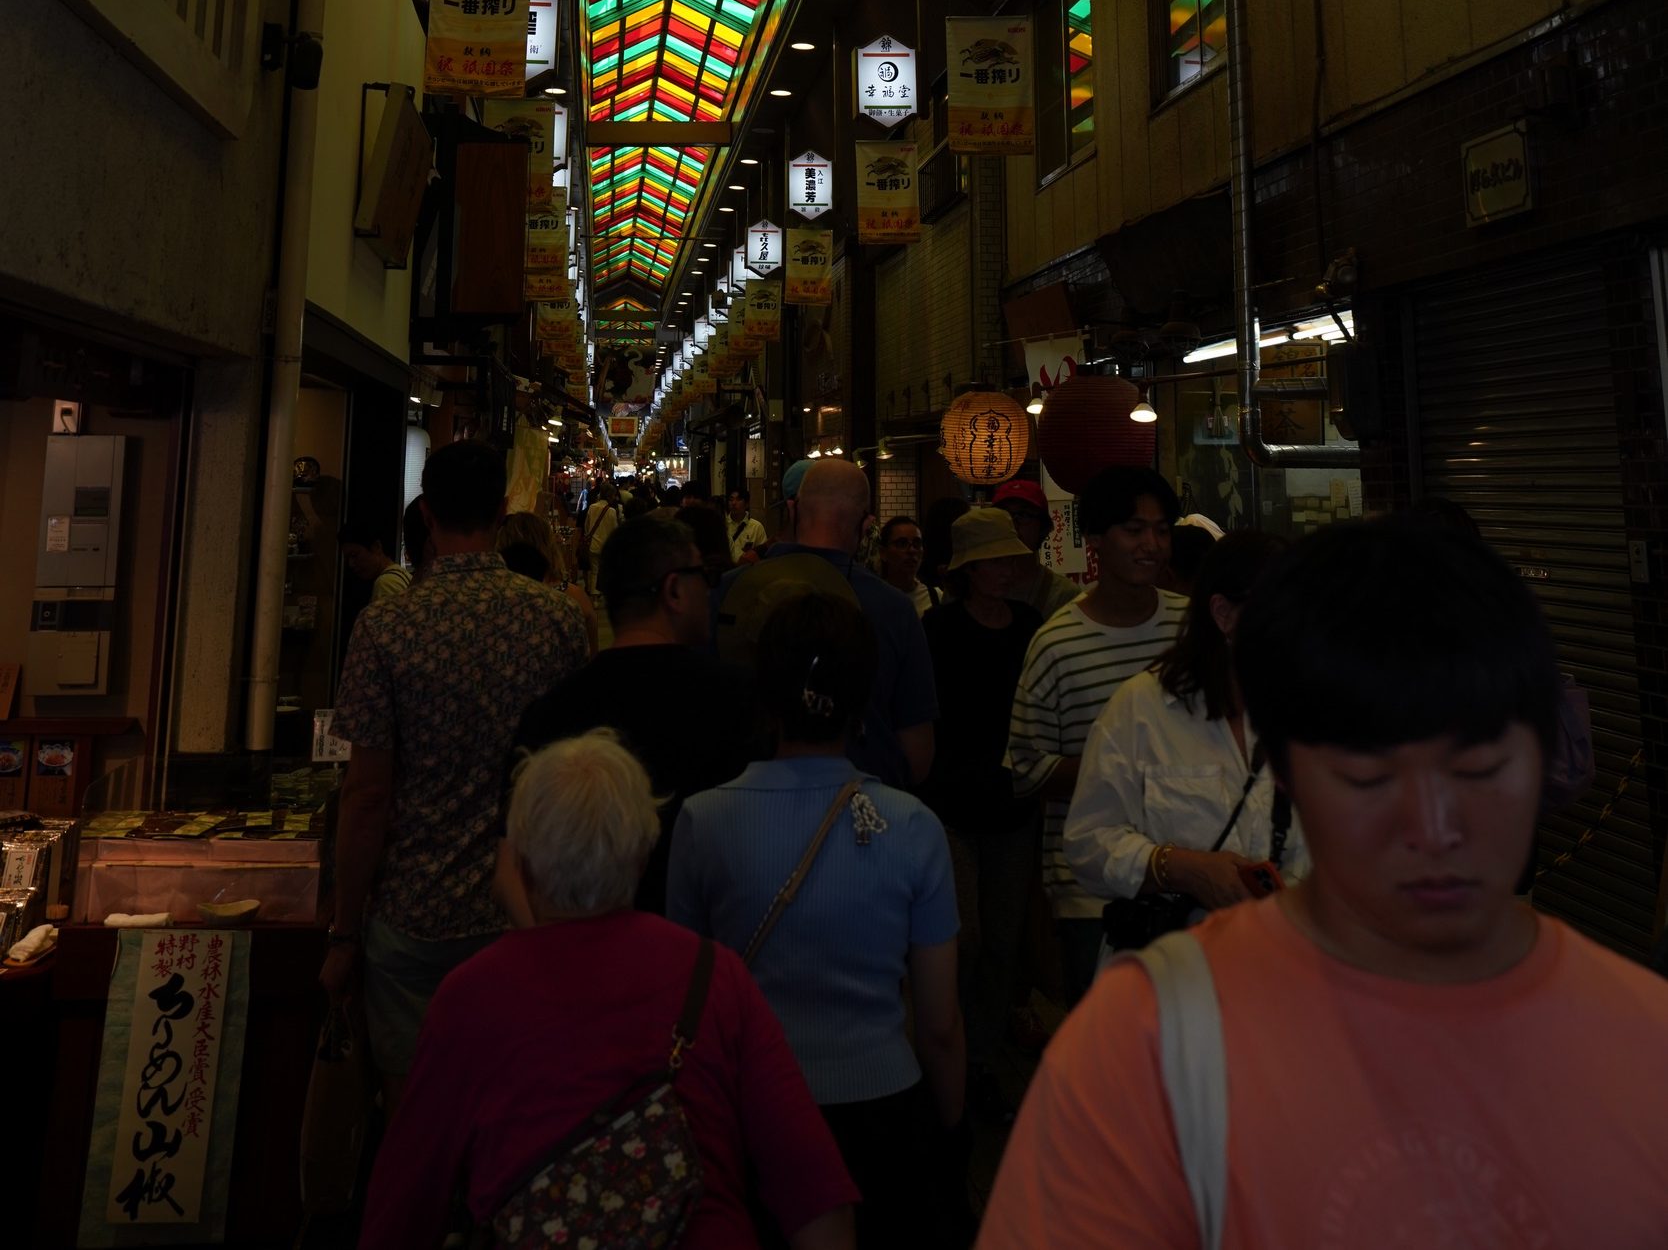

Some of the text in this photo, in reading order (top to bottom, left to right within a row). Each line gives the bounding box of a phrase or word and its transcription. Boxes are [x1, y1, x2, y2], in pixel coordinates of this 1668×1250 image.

[865, 84, 911, 98] 幸福堂
[960, 68, 1020, 84] 一番搾り
[805, 168, 816, 202] 美濃芳
[866, 177, 910, 190] 一番搾り
[528, 218, 558, 230] 番搾り
[151, 934, 178, 978] 特製
[176, 933, 199, 970] 野村
[181, 934, 224, 1138] 農林水産大臣賞受賞
[115, 972, 195, 1221] ちりめん山椒
